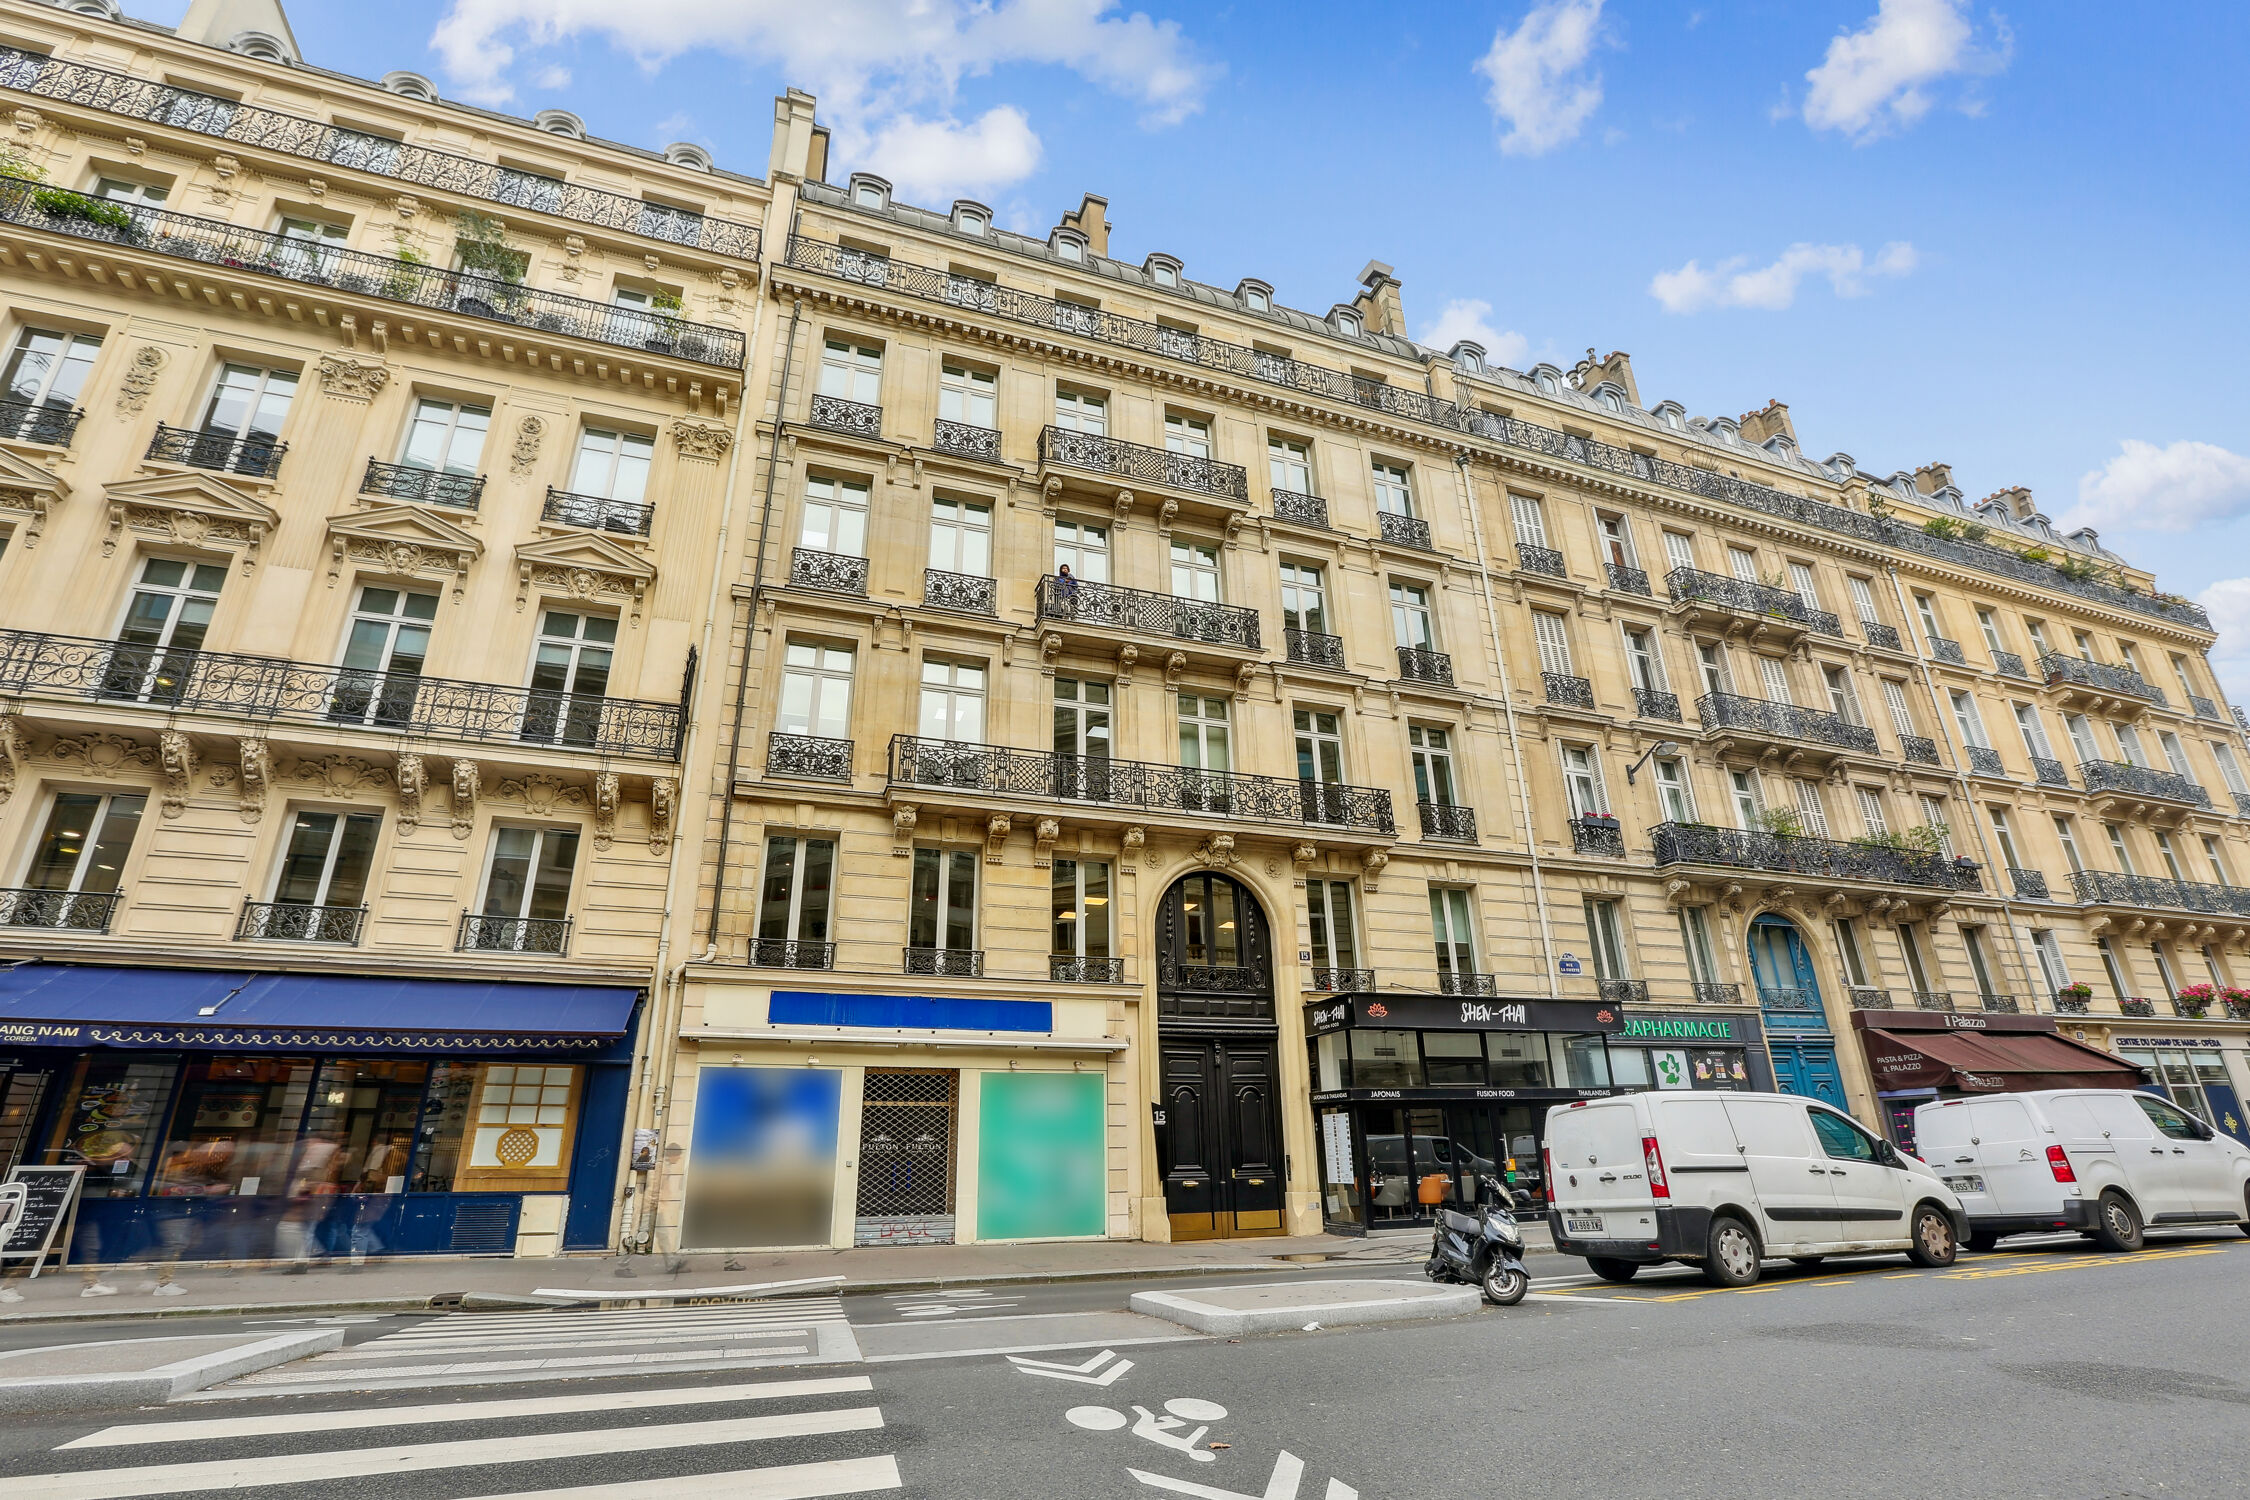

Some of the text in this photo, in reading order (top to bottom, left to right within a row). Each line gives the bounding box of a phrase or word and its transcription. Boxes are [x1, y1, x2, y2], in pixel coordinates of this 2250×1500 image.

[1300, 951, 1309, 960] 15
[1313, 1004, 1345, 1027] SHEN-THAI
[1460, 1002, 1526, 1025] SHEN-THAI
[1951, 1015, 1987, 1028] Palazzo
[38, 1026, 80, 1037] NAM
[1612, 1020, 1732, 1038] RAPHARMACIE
[2116, 1038, 2140, 1046] CENTRE
[2141, 1038, 2150, 1046] DU
[2181, 1039, 2199, 1047] MARS
[2201, 1037, 2222, 1047] OPÉRA
[1876, 1056, 1897, 1064] PASTA
[1903, 1053, 1923, 1061] PIZZA
[1890, 1063, 1922, 1072] PALAZZO
[1371, 1090, 1401, 1099] JAPONAIS
[1476, 1090, 1515, 1098] FUSION FOOD
[1153, 1110, 1166, 1121] 15
